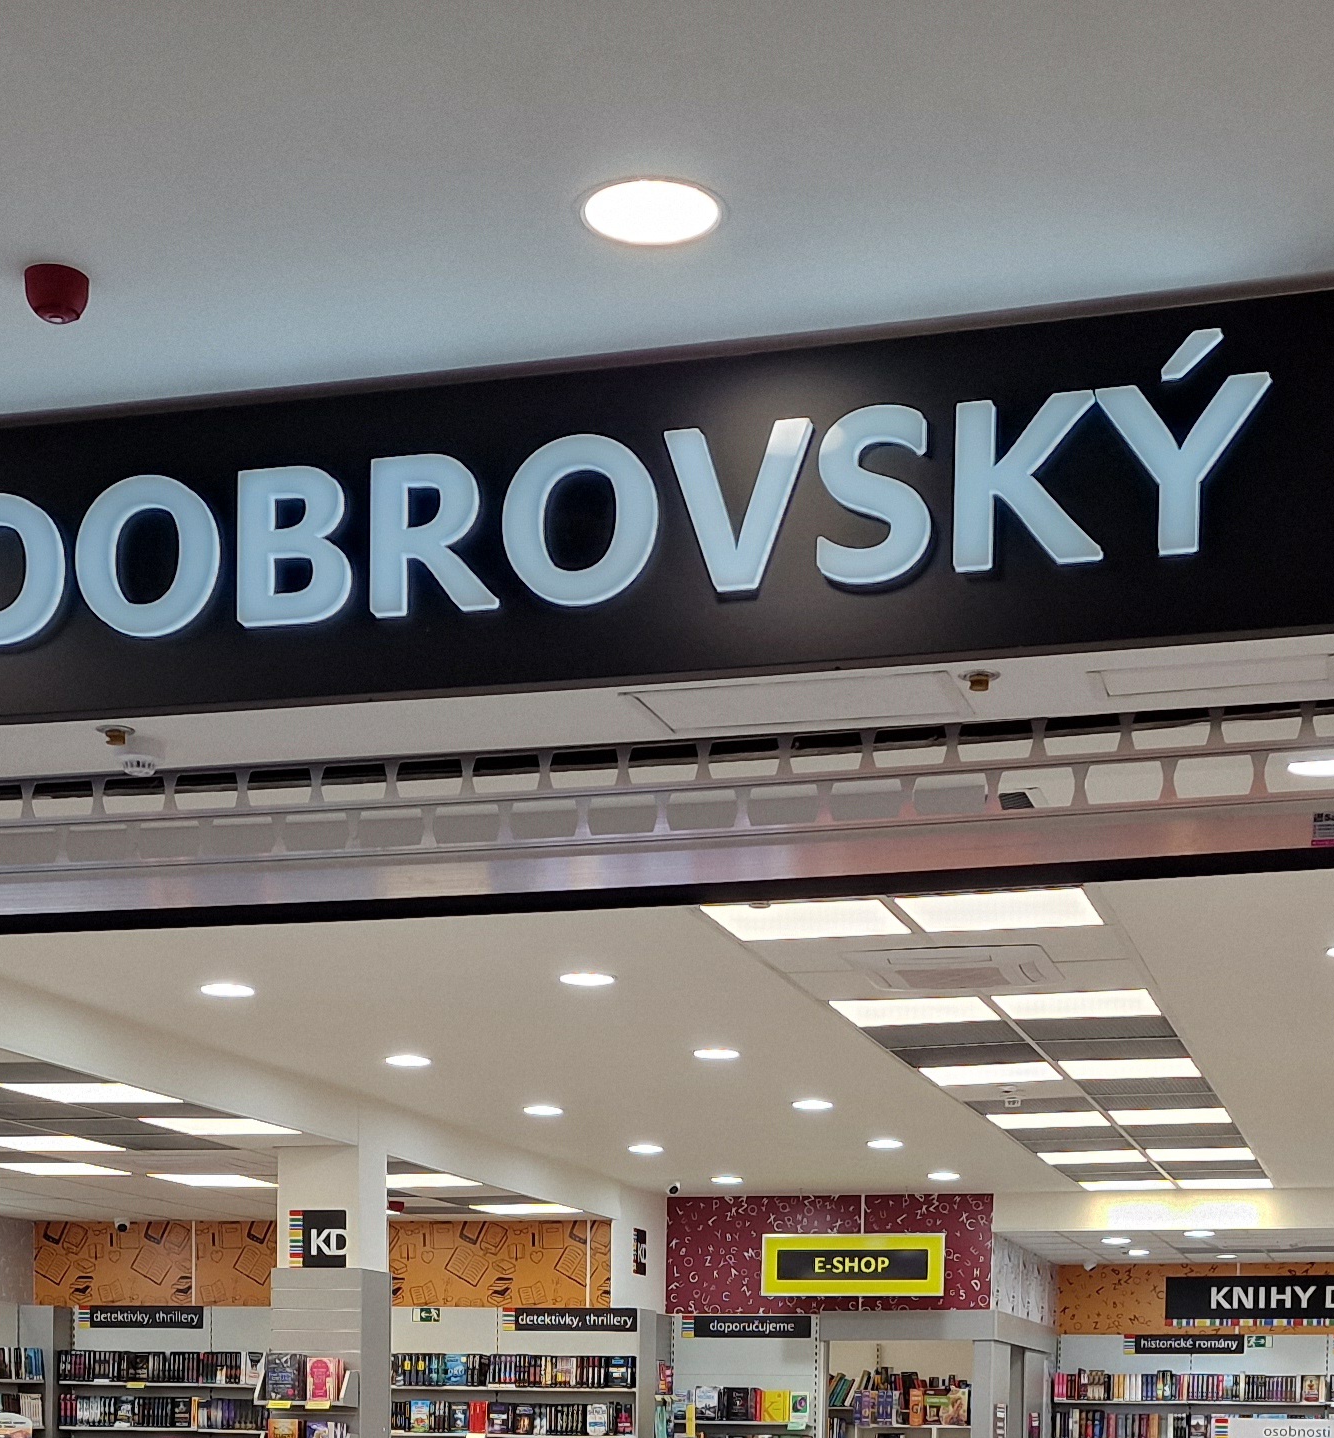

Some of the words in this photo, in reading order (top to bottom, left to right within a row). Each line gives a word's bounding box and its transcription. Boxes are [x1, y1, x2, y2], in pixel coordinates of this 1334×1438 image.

[310, 1228, 348, 1256] KD
[813, 1256, 890, 1274] E-SHOP
[1210, 1285, 1317, 1310] KNIHY
[93, 1309, 153, 1325] detektivky,
[155, 1310, 200, 1326] thrillery
[518, 1312, 583, 1329] detektivky,
[585, 1313, 633, 1329] thrillery
[709, 1319, 795, 1334] doporučujeme
[1140, 1337, 1194, 1349] historické
[1195, 1337, 1239, 1351] romány
[1263, 1425, 1331, 1438] osobnosti
